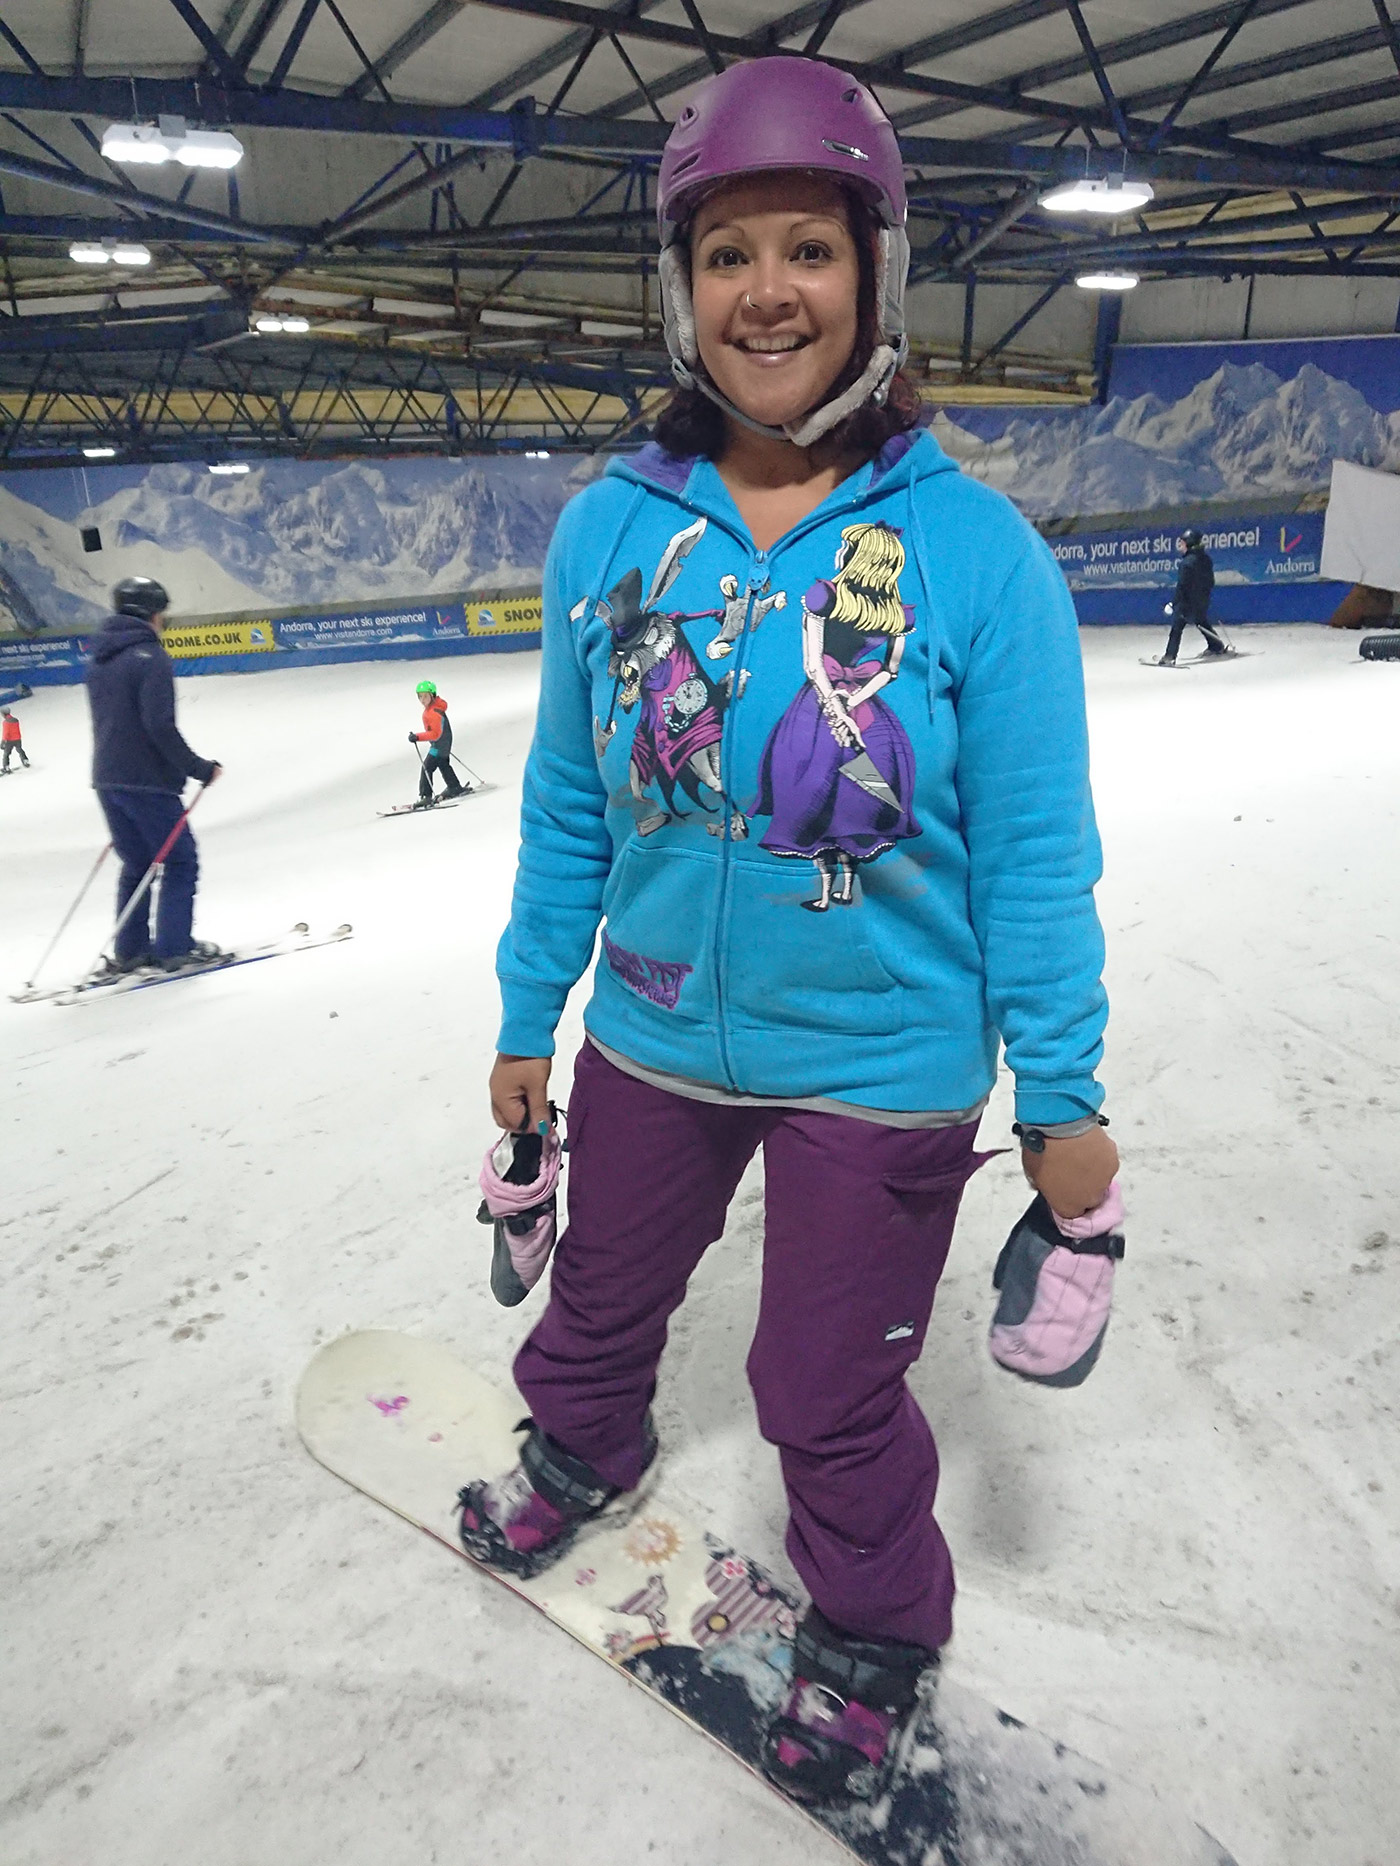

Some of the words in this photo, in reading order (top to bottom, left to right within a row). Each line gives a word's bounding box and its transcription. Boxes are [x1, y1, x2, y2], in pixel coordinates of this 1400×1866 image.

[1052, 543, 1087, 561] dorra,
[1091, 542, 1118, 561] your
[1121, 537, 1150, 555] next
[1153, 535, 1171, 553] ski
[1265, 558, 1315, 574] Andorra
[280, 621, 316, 633] Andorra,
[318, 620, 337, 632] your
[339, 617, 359, 629] next
[361, 616, 374, 627] ski
[375, 611, 427, 626] experience!
